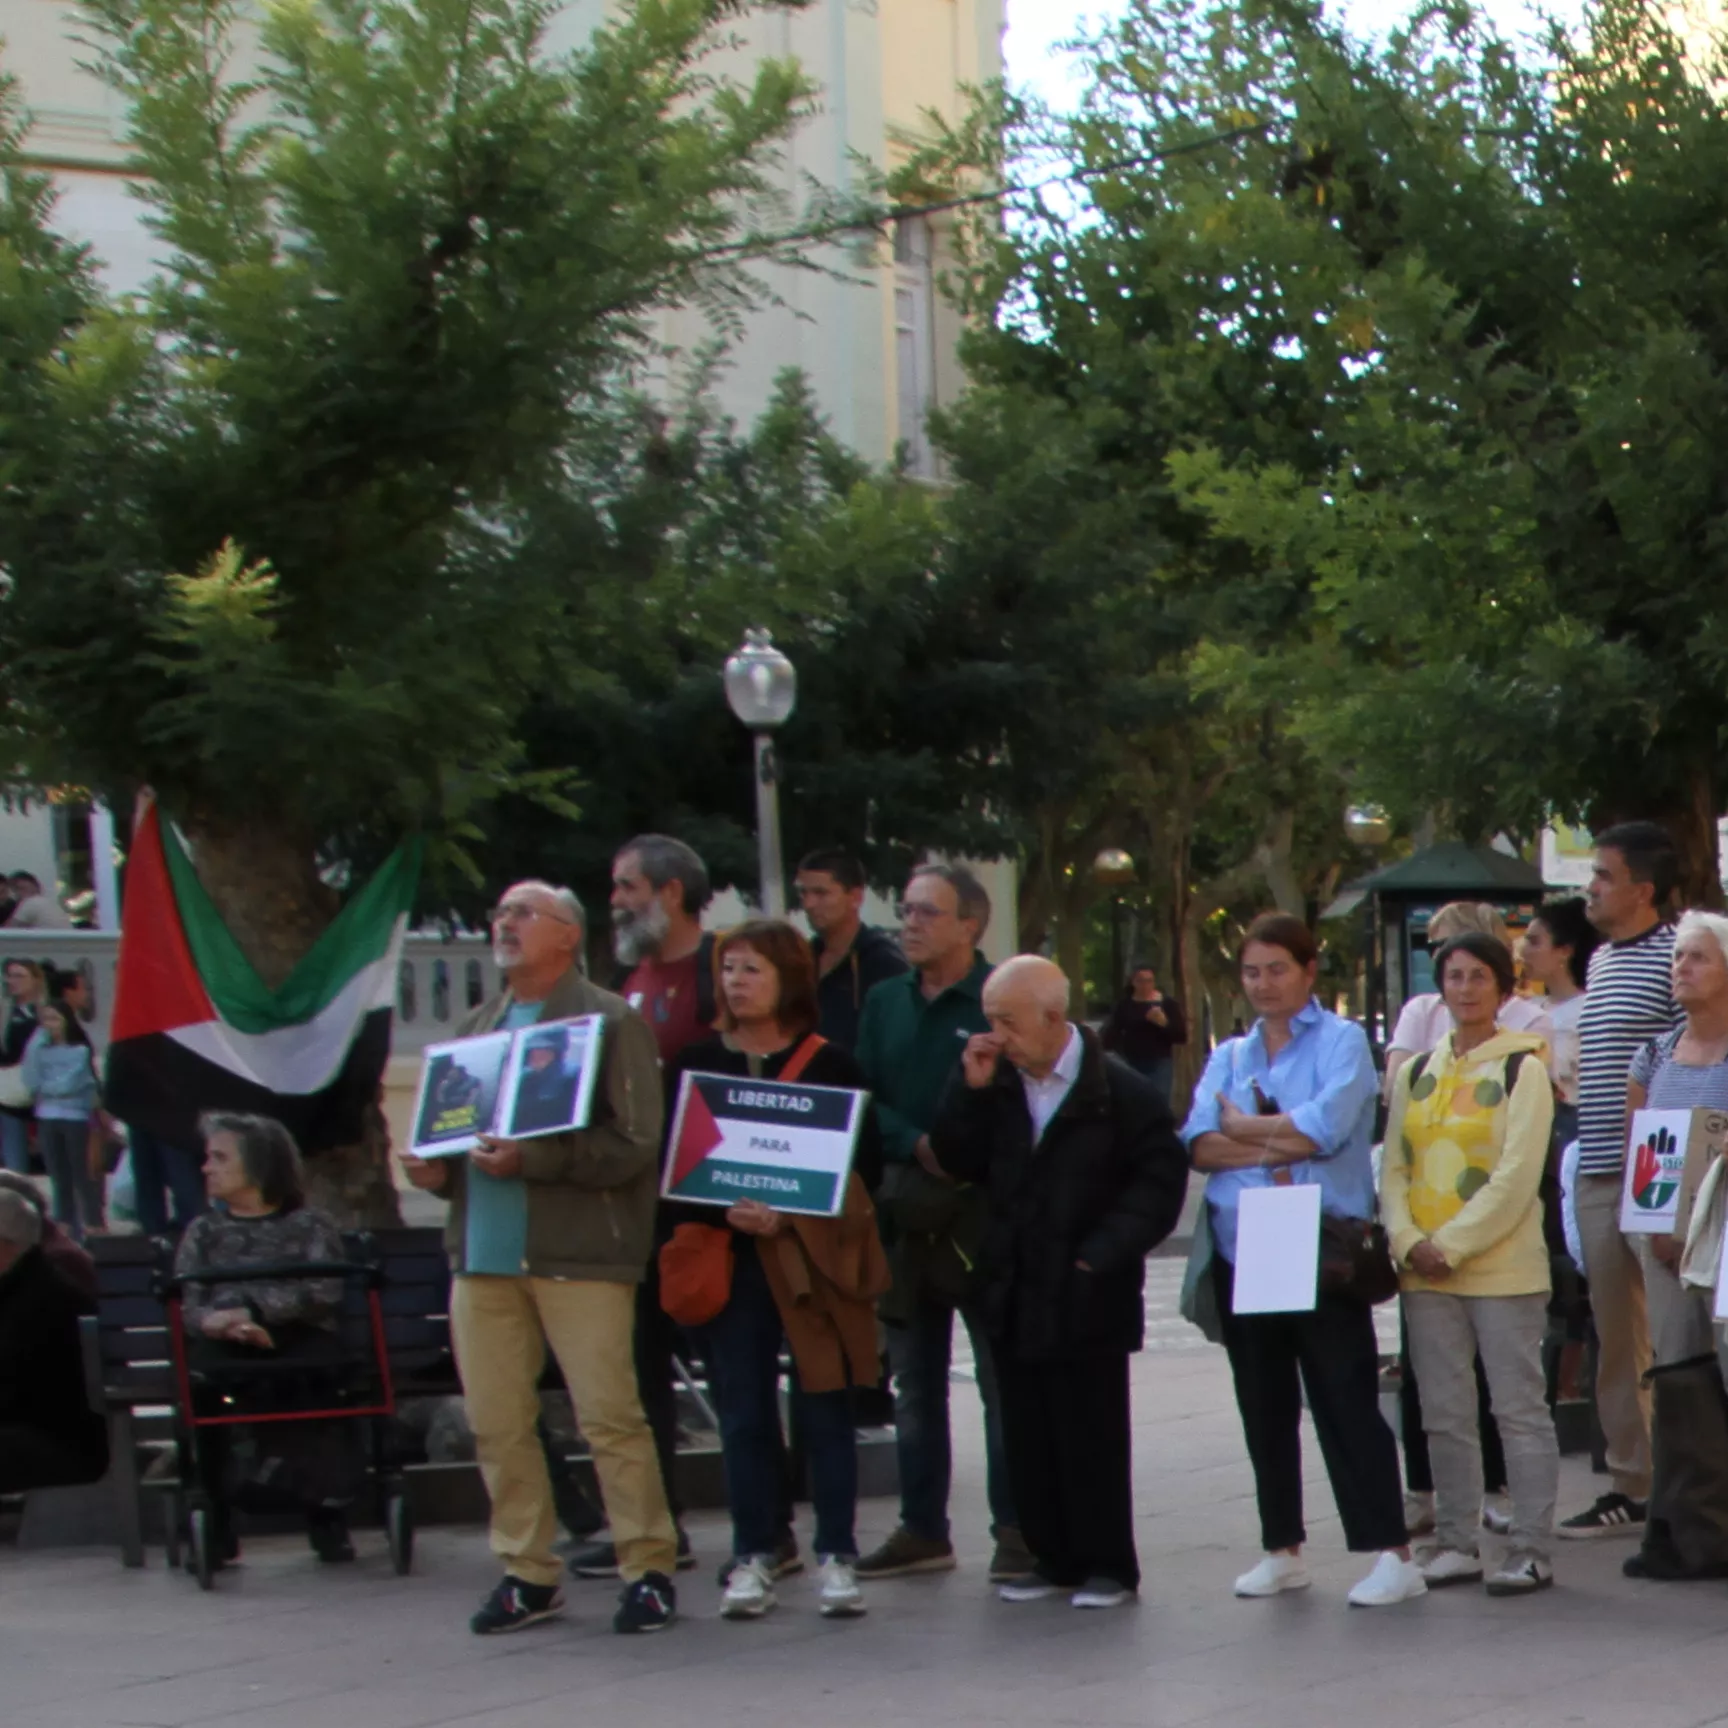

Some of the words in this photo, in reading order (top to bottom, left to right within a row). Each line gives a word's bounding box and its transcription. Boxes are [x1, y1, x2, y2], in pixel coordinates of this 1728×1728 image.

[727, 1088, 815, 1112] LIBERTAD
[750, 1137, 791, 1153] PARA
[711, 1169, 801, 1192] PALESTINA
